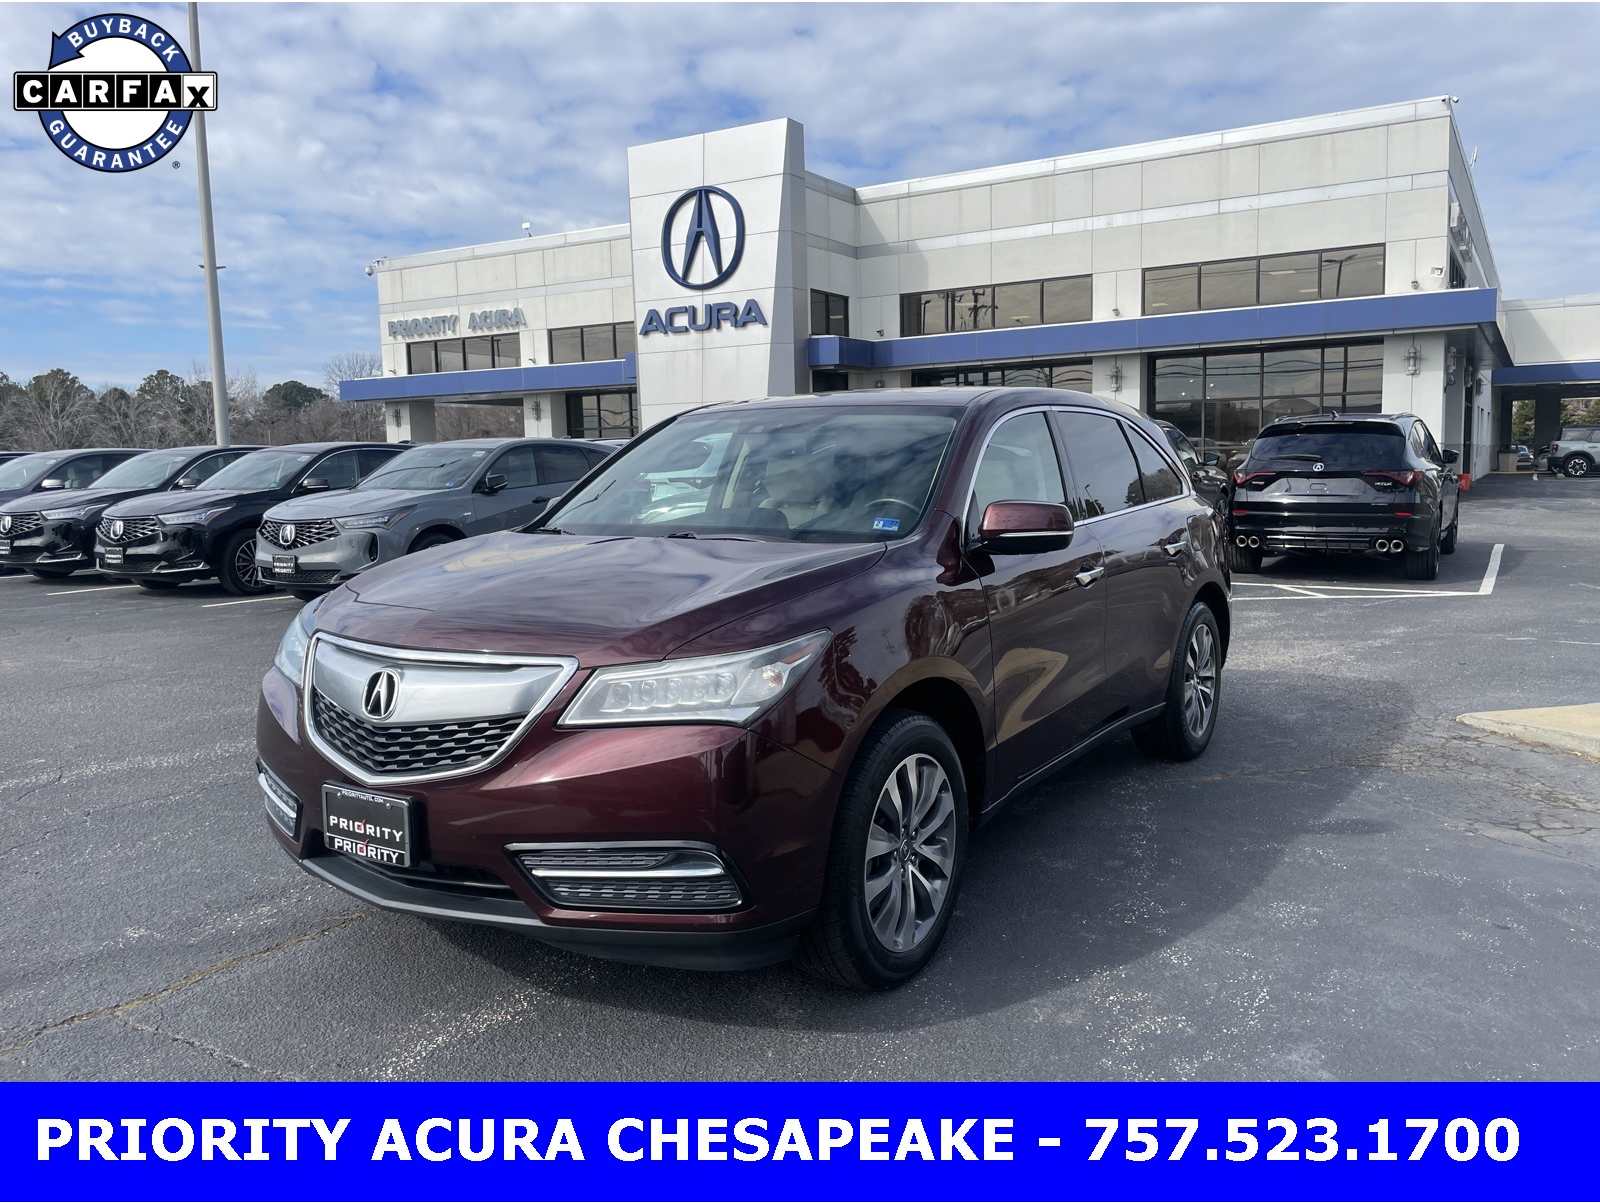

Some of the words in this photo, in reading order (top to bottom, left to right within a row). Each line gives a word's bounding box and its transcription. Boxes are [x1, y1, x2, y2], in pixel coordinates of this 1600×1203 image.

[387, 314, 458, 339] PRIORITY
[467, 307, 527, 333] ACURA
[639, 298, 767, 335] ACURA
[329, 815, 403, 842] PRIORITY
[334, 838, 399, 863] PRIORITY
